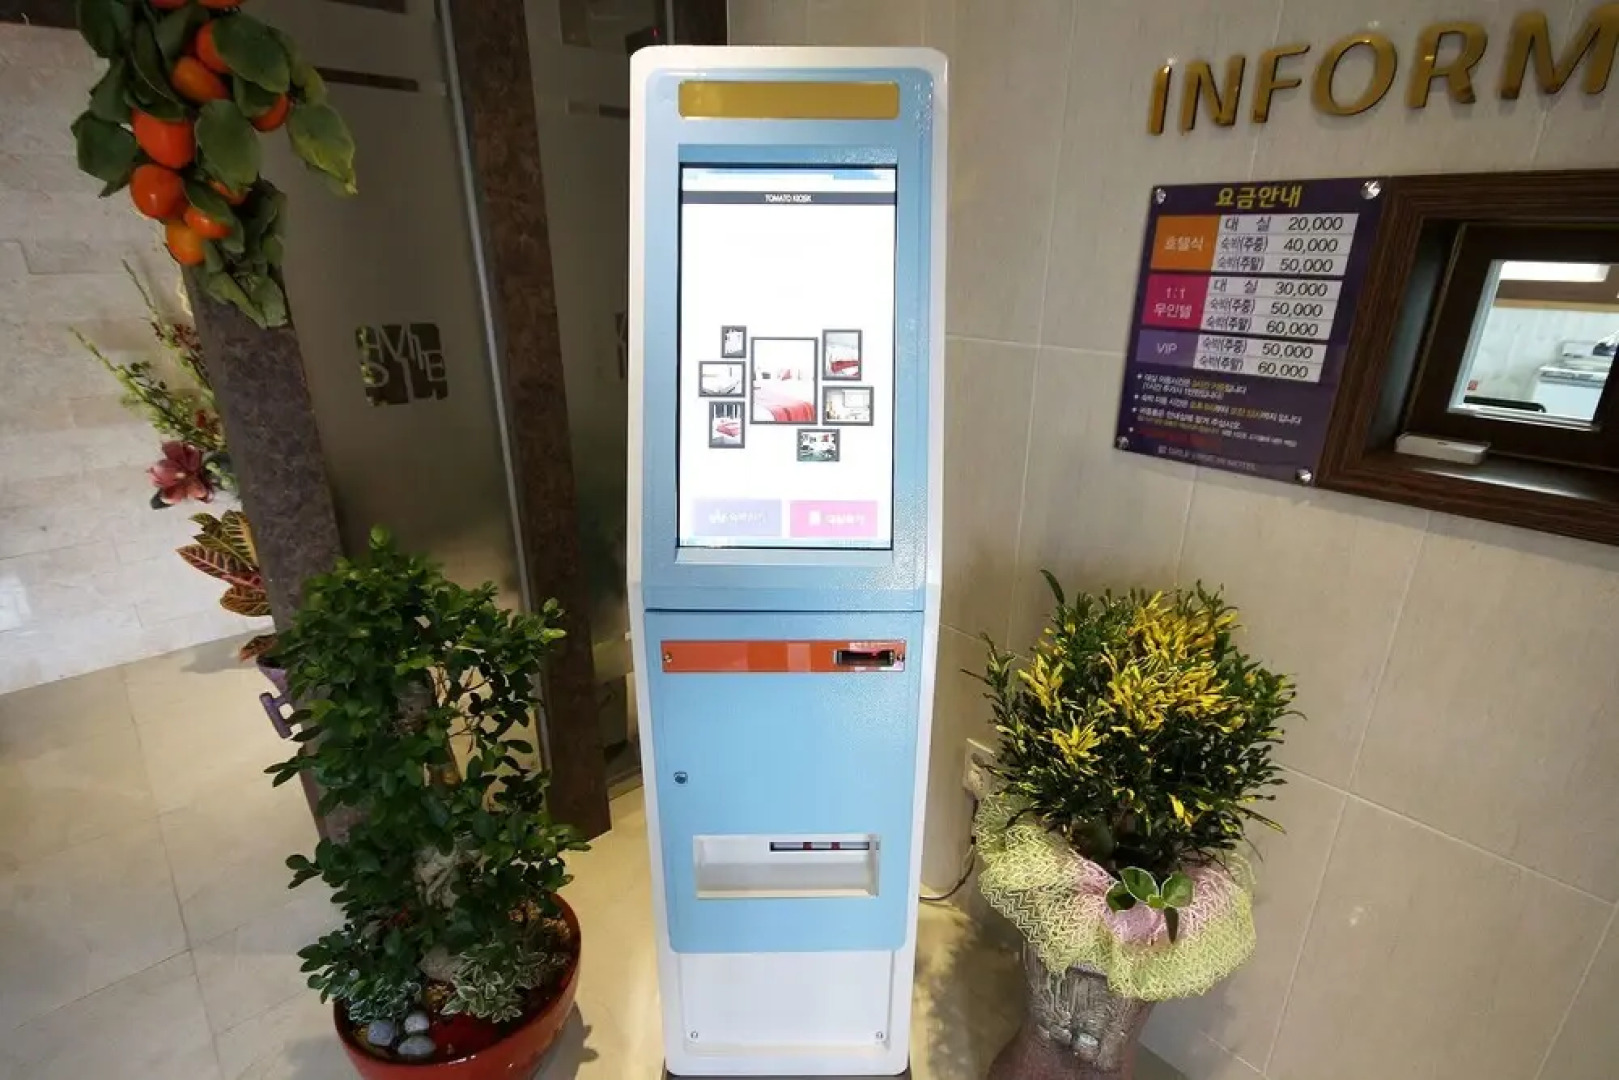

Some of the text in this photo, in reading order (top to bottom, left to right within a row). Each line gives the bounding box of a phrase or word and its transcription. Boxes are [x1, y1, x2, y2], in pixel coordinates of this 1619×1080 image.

[764, 193, 792, 203] TOMATO
[1215, 185, 1303, 210] 요금안내
[1288, 216, 1344, 233] 20,000
[1283, 237, 1339, 254] 40,000
[1279, 257, 1334, 274] 50,000
[1274, 281, 1329, 298] 30,000
[1270, 302, 1324, 318] 50,000
[1265, 319, 1319, 337] 60,000
[1156, 342, 1178, 355] VIP
[1261, 342, 1314, 360] 50,000
